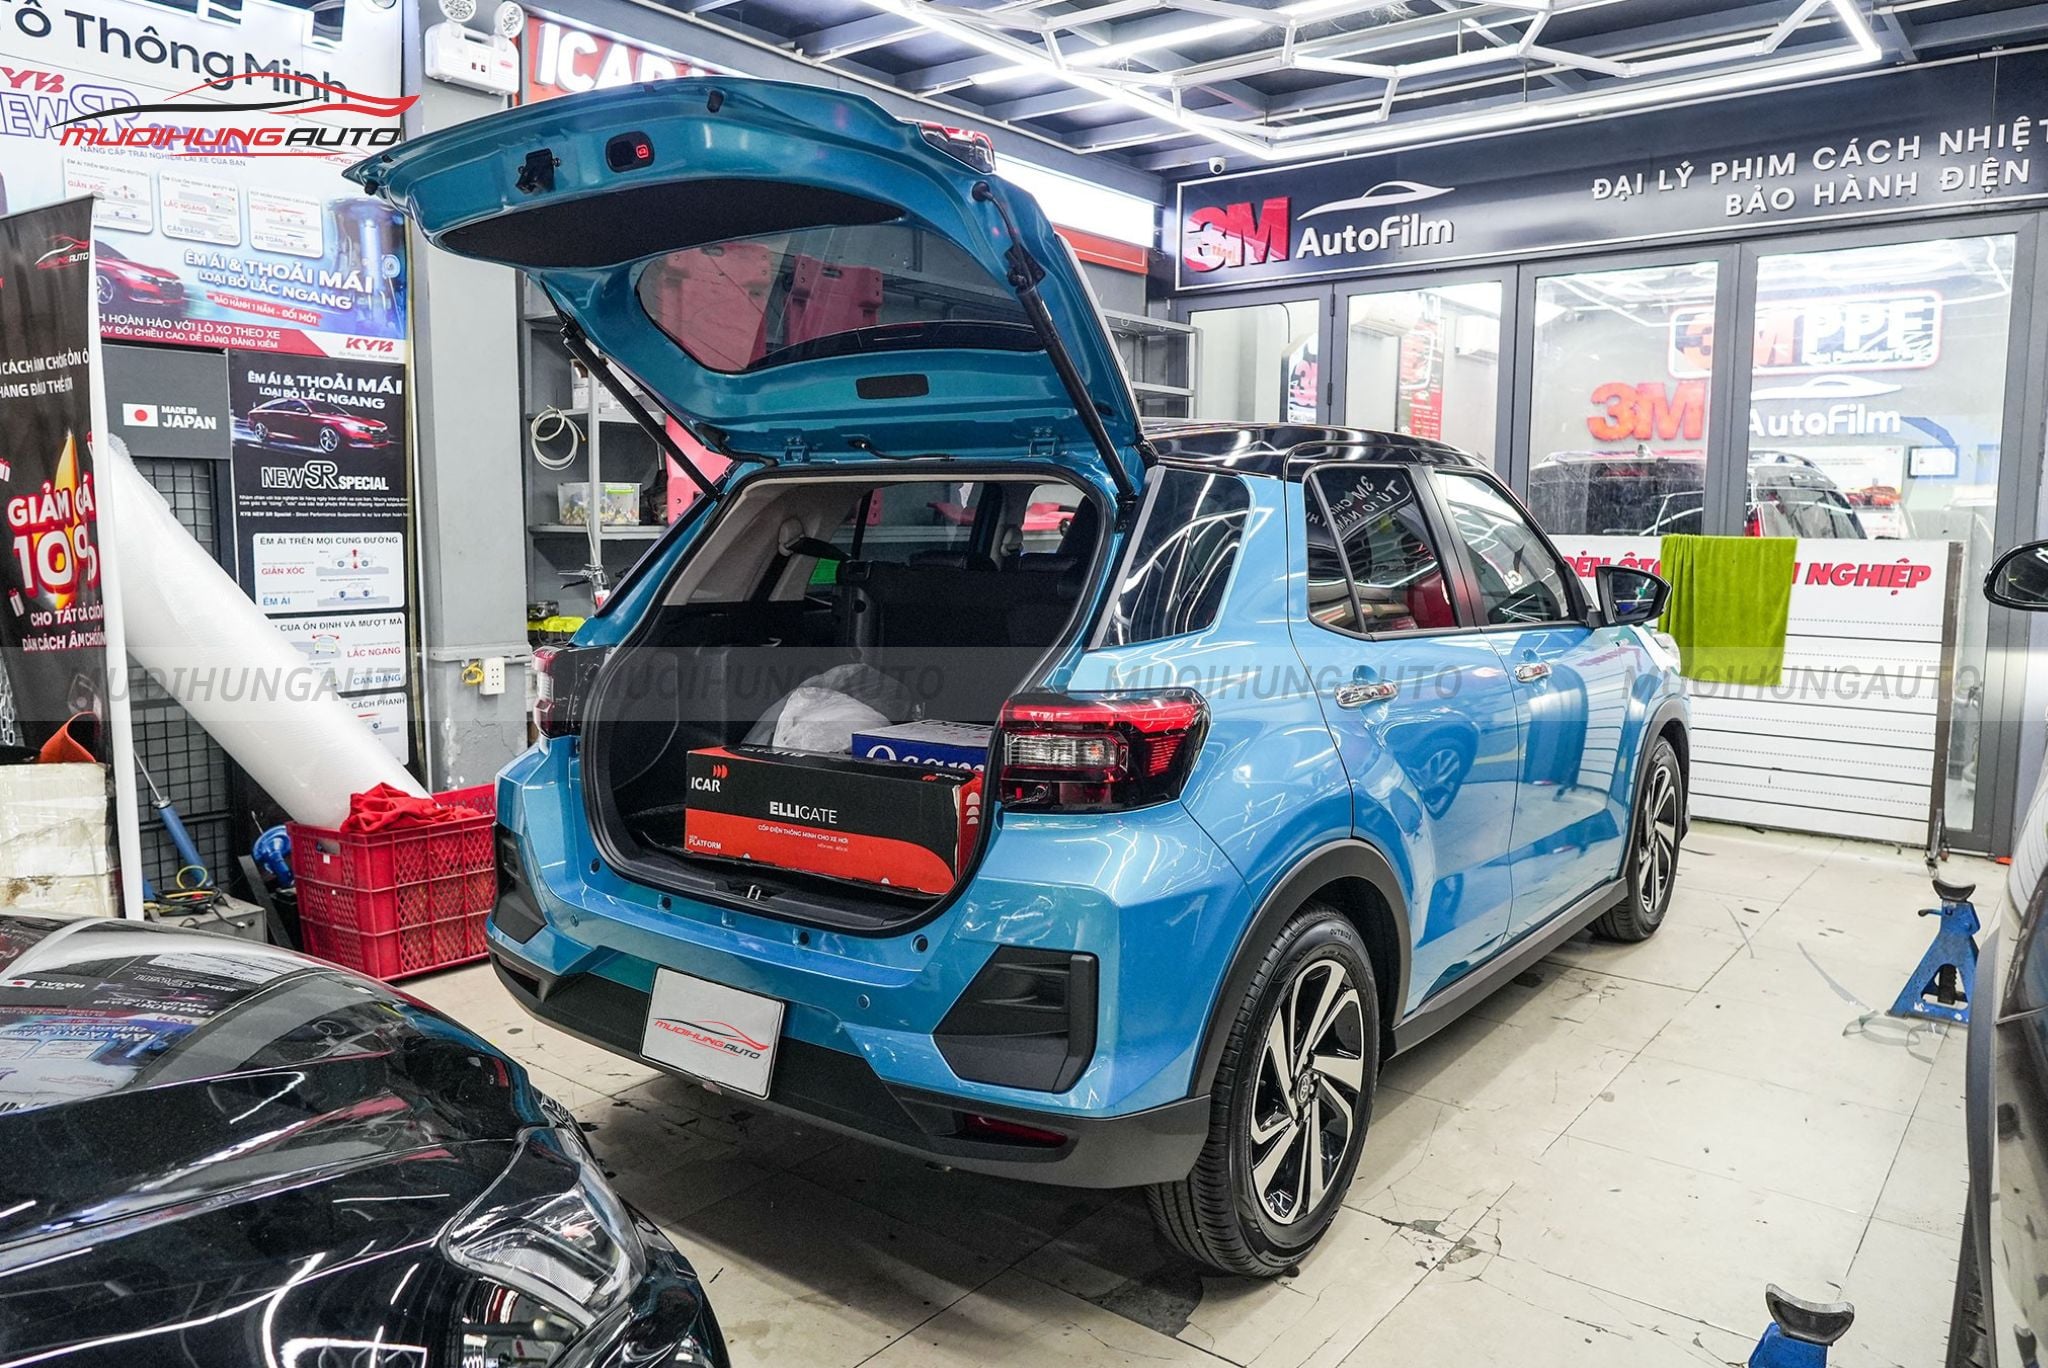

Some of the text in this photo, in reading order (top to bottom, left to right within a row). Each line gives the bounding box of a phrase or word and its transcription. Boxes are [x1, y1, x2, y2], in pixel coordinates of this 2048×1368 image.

[65, 10, 234, 91] Thông
[245, 52, 348, 104] Minh
[0, 67, 65, 93] YB
[0, 92, 68, 140] EW
[1592, 172, 1644, 201] ĐẠI
[1658, 161, 1695, 191] LÝ
[1710, 151, 1797, 185] PHIM
[1812, 135, 1921, 171] CÁCH
[1725, 157, 2030, 217] BẢO HÀNH ĐIỆN
[1184, 196, 1454, 272] 3M AutoFilm
[185, 252, 373, 294] ÊM ÁI & THOẢI MÁI
[199, 271, 353, 310] LOẠI BỎ LẮC NGANG
[109, 313, 144, 327] HOÀN
[146, 317, 172, 330] HẢO
[174, 319, 196, 332] VỚI
[199, 322, 212, 333] LÒ
[216, 325, 232, 335] XO
[235, 327, 264, 338] THEO
[267, 329, 281, 340] XE
[346, 337, 394, 353] KYB
[248, 371, 403, 395] ÊM ÁI & THOẢI MÁI
[162, 405, 182, 415] MADE
[259, 387, 386, 410] LOẠI BỎ LẮC NGANG
[1587, 380, 1706, 441] 3M
[162, 416, 217, 430] JAPAN
[338, 476, 389, 490] SPECIAL
[8, 482, 70, 527] GIẢM
[289, 535, 314, 545] TRÊN
[335, 536, 362, 545] CUNG
[1805, 558, 1932, 596] NGHIỆP
[31, 611, 52, 627] CHO
[280, 622, 301, 632] CUA
[319, 621, 342, 632] ĐỊNH
[368, 645, 401, 657] NGANG
[690, 776, 721, 792] ICAR
[769, 801, 838, 824] ELLIGATE
